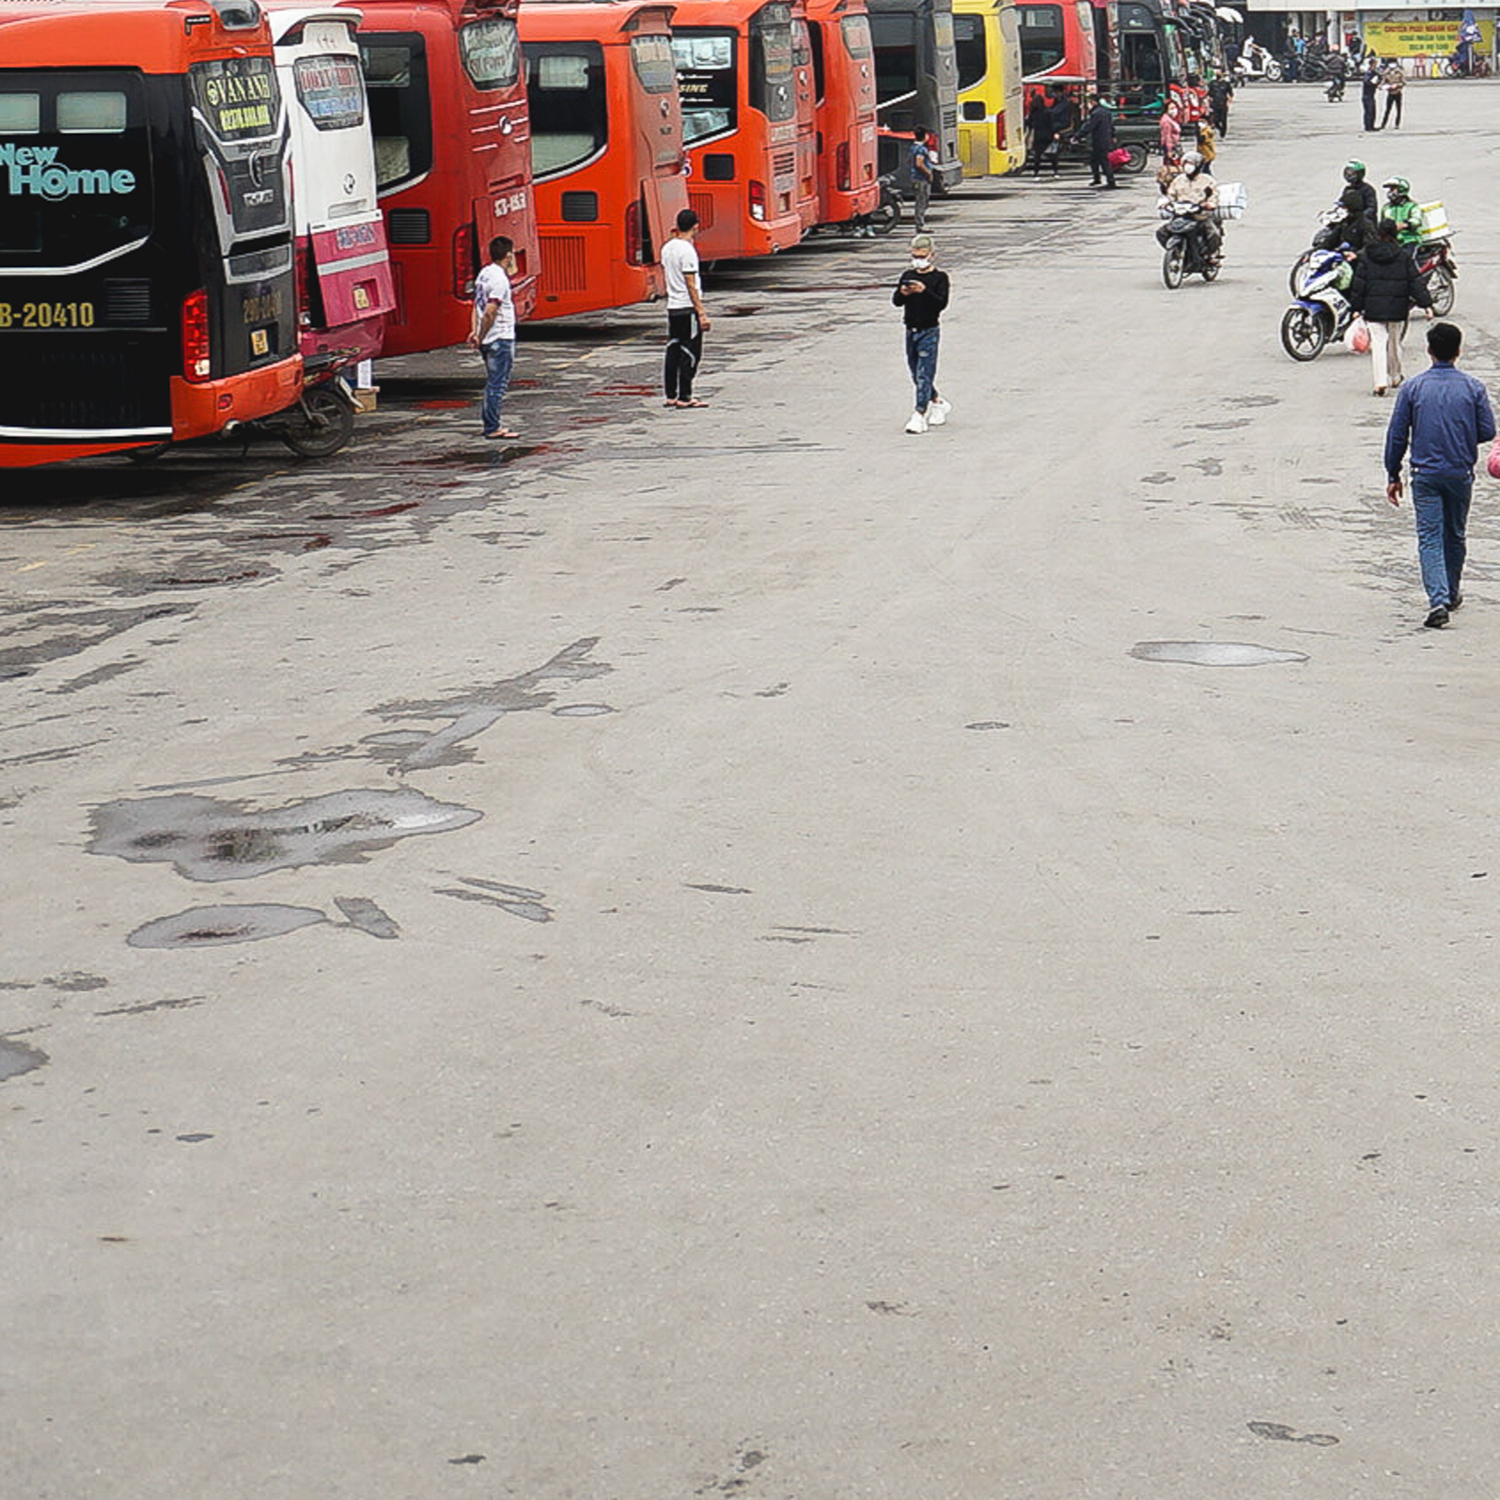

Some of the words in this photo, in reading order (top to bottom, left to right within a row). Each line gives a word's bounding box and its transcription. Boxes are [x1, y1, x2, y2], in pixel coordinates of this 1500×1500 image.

[247, 74, 270, 100] ANH
[0, 143, 59, 166] New
[9, 164, 136, 200] Home
